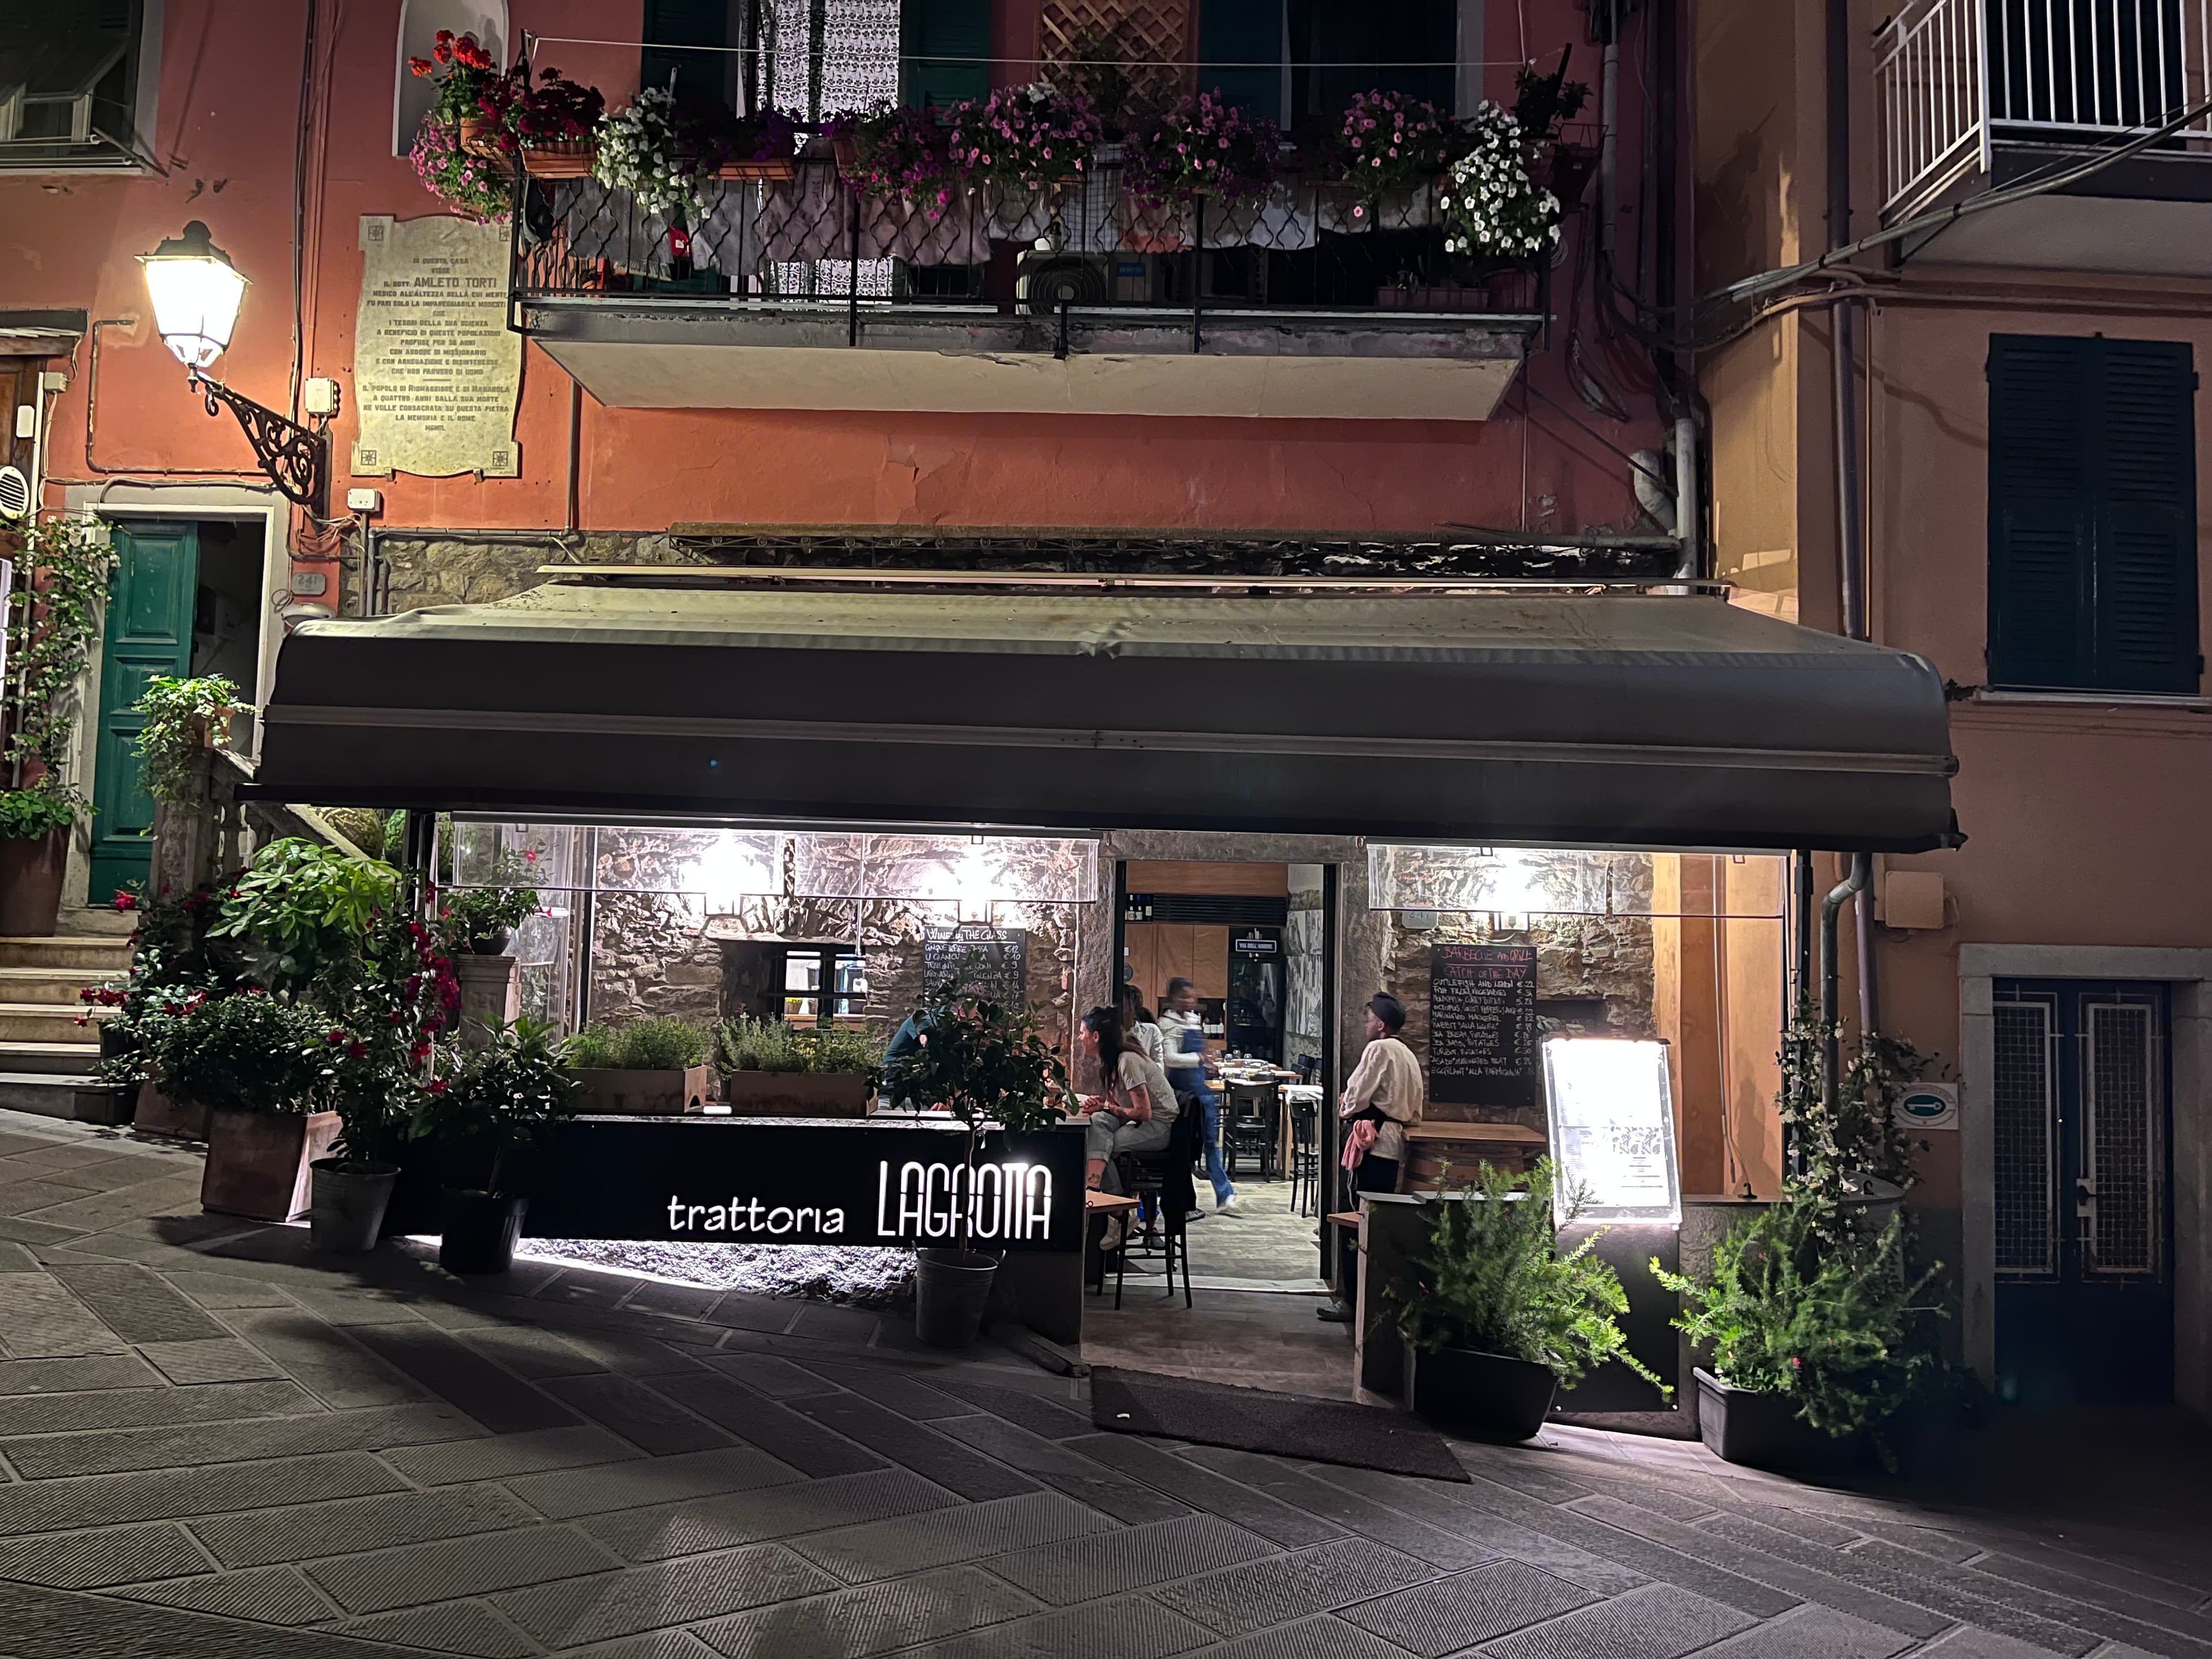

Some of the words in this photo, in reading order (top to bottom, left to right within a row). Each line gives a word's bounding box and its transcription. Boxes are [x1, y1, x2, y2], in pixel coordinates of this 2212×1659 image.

[414, 277, 459, 287] AMLETO
[465, 277, 497, 288] TORTI
[298, 575, 317, 585] 241
[962, 929, 979, 940] THE
[980, 930, 1007, 941] GLASS
[1441, 946, 1493, 961] BARBECUE
[1444, 966, 1475, 978] CATCH
[1489, 968, 1503, 979] THE
[1506, 968, 1527, 979] DAY
[667, 1195, 844, 1234] trattoria
